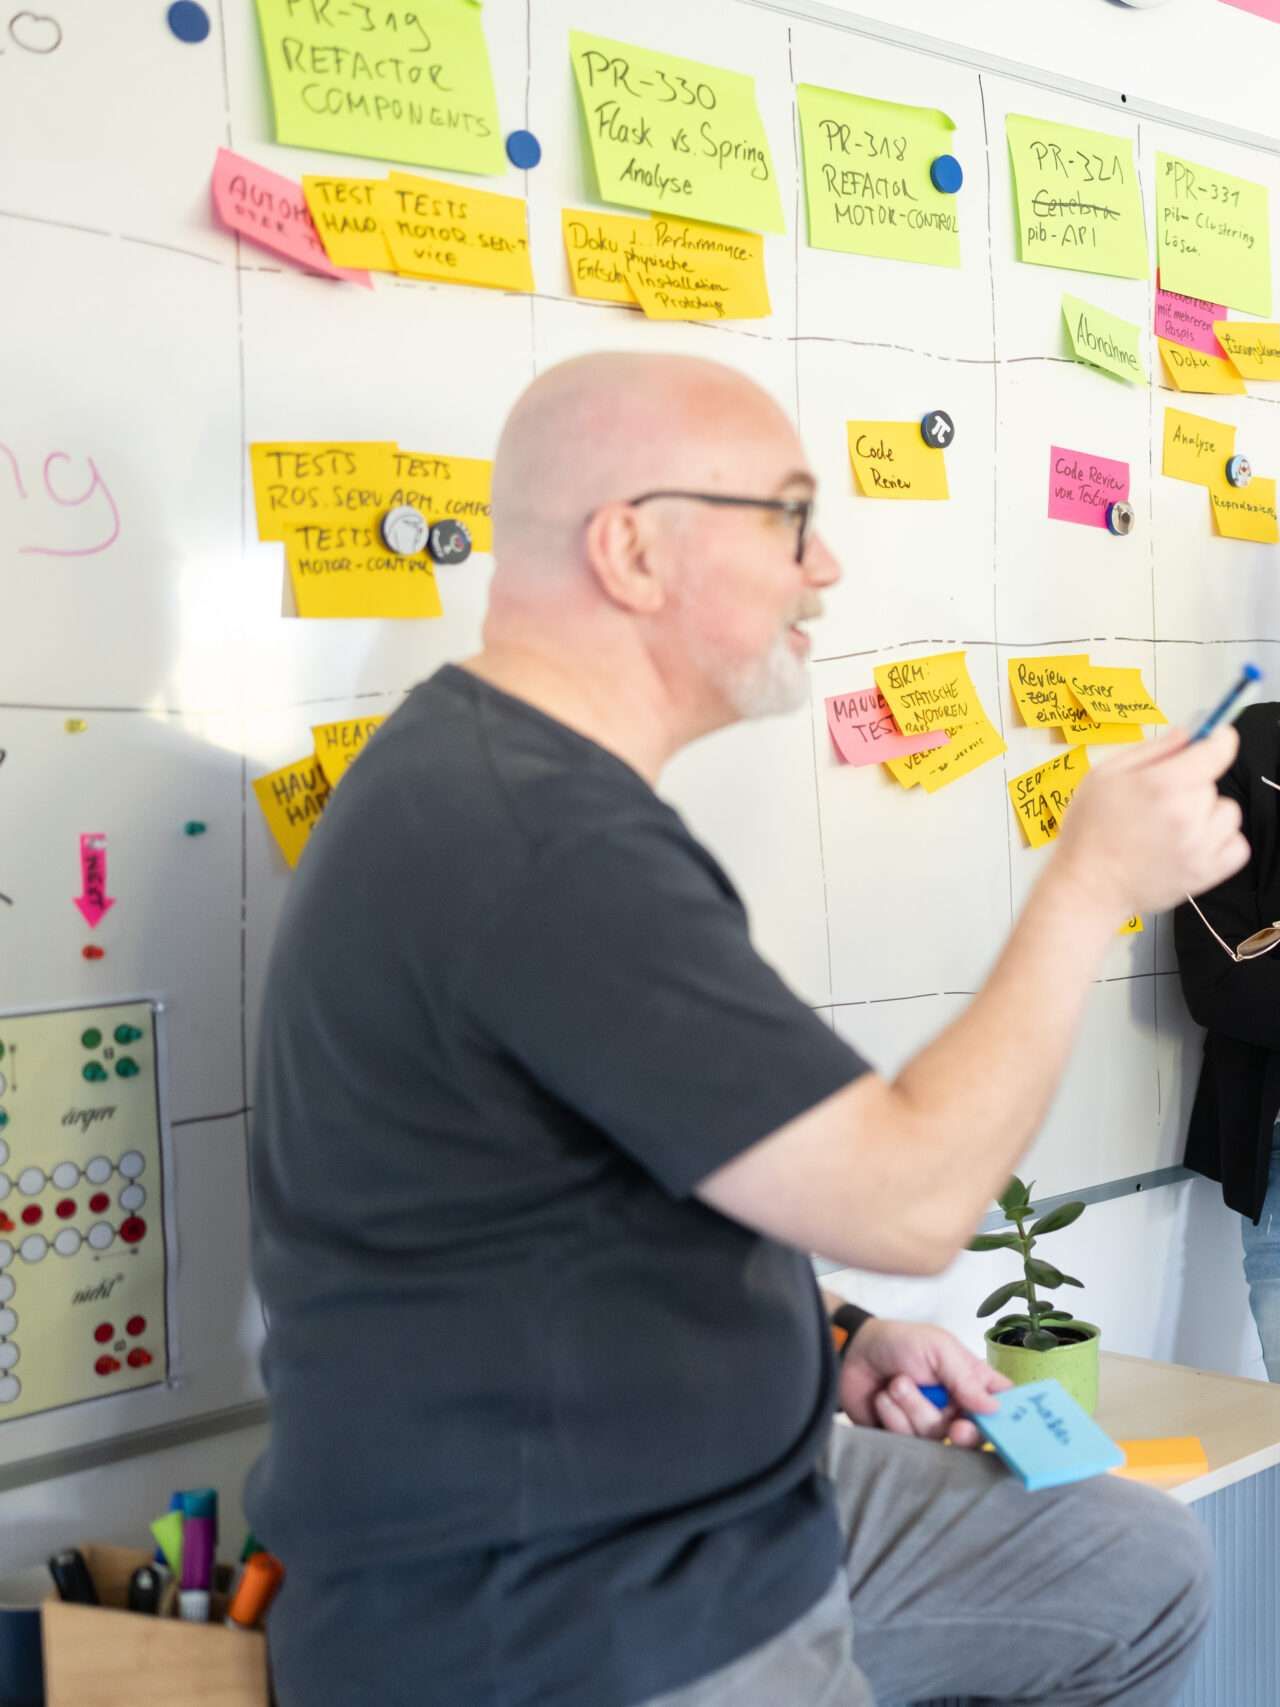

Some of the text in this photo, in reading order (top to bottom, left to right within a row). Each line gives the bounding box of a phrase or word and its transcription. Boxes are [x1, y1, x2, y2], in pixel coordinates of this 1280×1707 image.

[282, 37, 453, 91] REFACTOR
[582, 50, 717, 110] PR-330
[302, 83, 491, 138] COMPONENTS
[594, 100, 653, 148] Flask
[700, 121, 769, 181] Spring
[819, 119, 908, 161] PR-318
[619, 157, 693, 199] Analyse
[1030, 141, 1124, 184] PR-321
[315, 181, 374, 206] TEST
[822, 163, 918, 201] REFACTOR
[394, 190, 468, 221] TESTS
[569, 222, 618, 253] Doku
[1076, 311, 1140, 371] Abnahme
[1170, 350, 1210, 368] Doku
[856, 434, 895, 462] Code
[1172, 423, 1216, 457] Analyse
[266, 448, 357, 479] TESTS
[392, 453, 451, 480] TESTS
[870, 467, 911, 489] Review
[1055, 458, 1125, 491] Code Review
[295, 526, 374, 552] TESTS
[1017, 663, 1067, 687] Review
[1072, 677, 1114, 698] Server
[900, 677, 959, 709] STATISCHE
